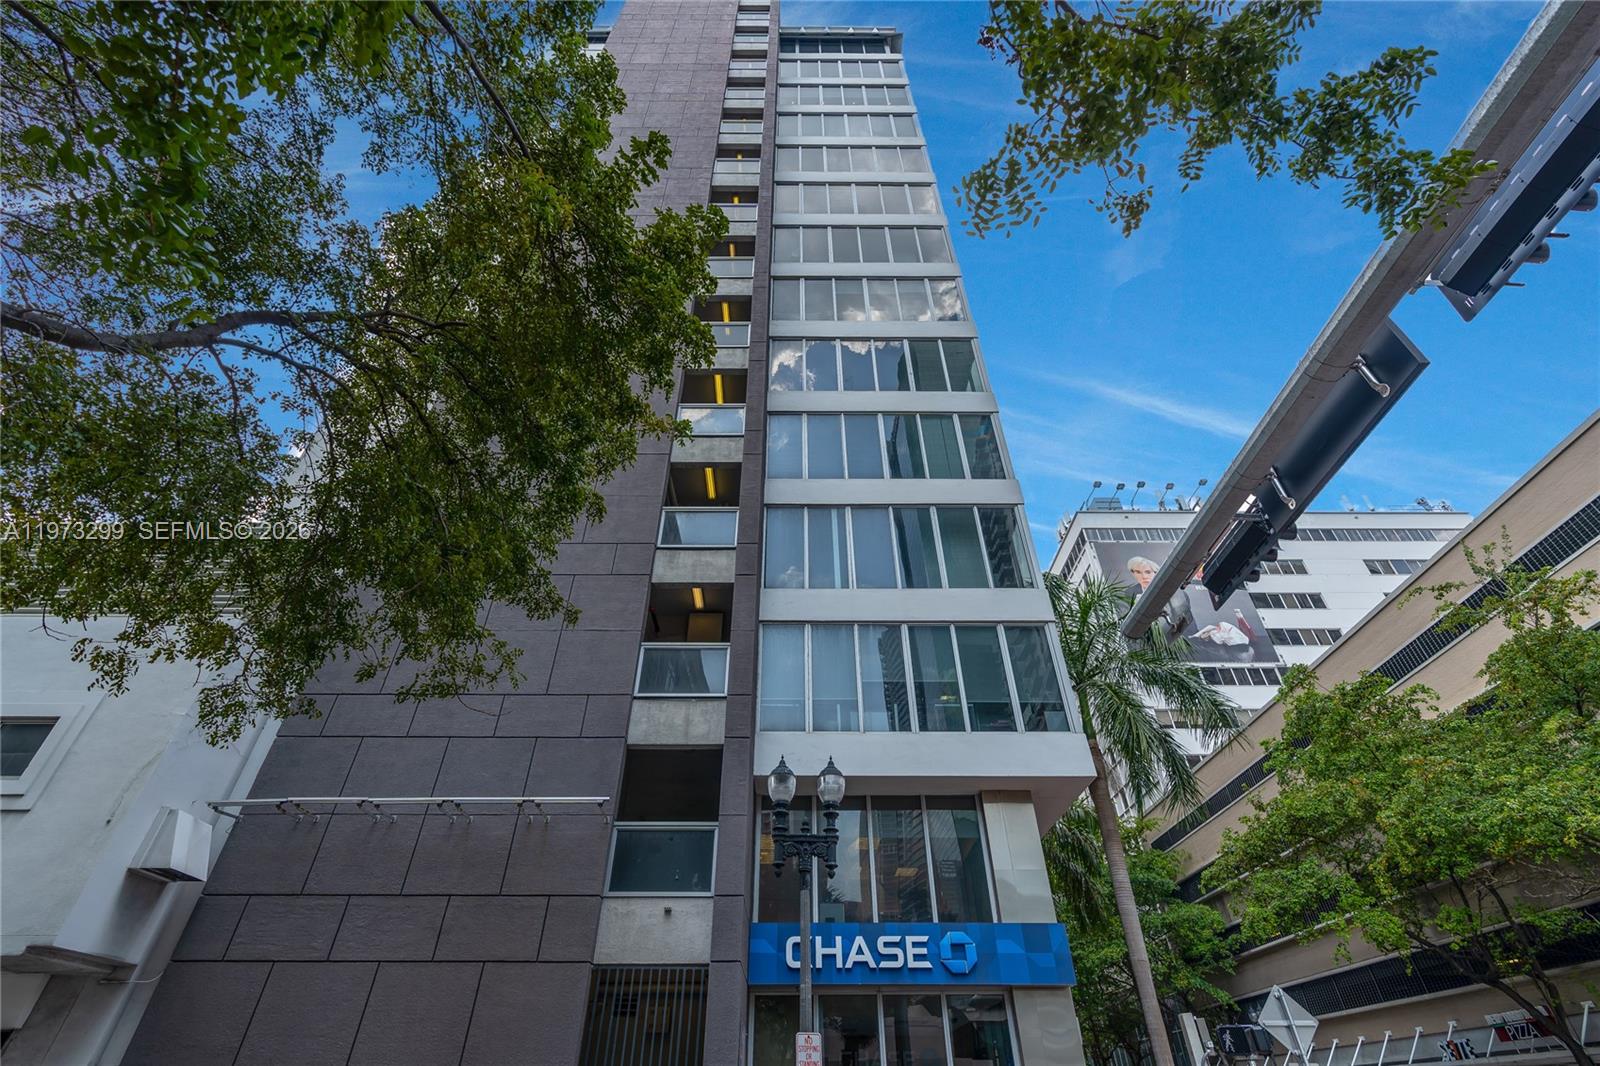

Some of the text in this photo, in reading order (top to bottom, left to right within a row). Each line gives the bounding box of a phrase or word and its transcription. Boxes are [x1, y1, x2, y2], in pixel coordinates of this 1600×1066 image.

[785, 935, 933, 969] CHASE
[1505, 1023, 1544, 1040] PIZZA
[804, 1037, 813, 1045] NO
[798, 1045, 820, 1053] STOPPING
